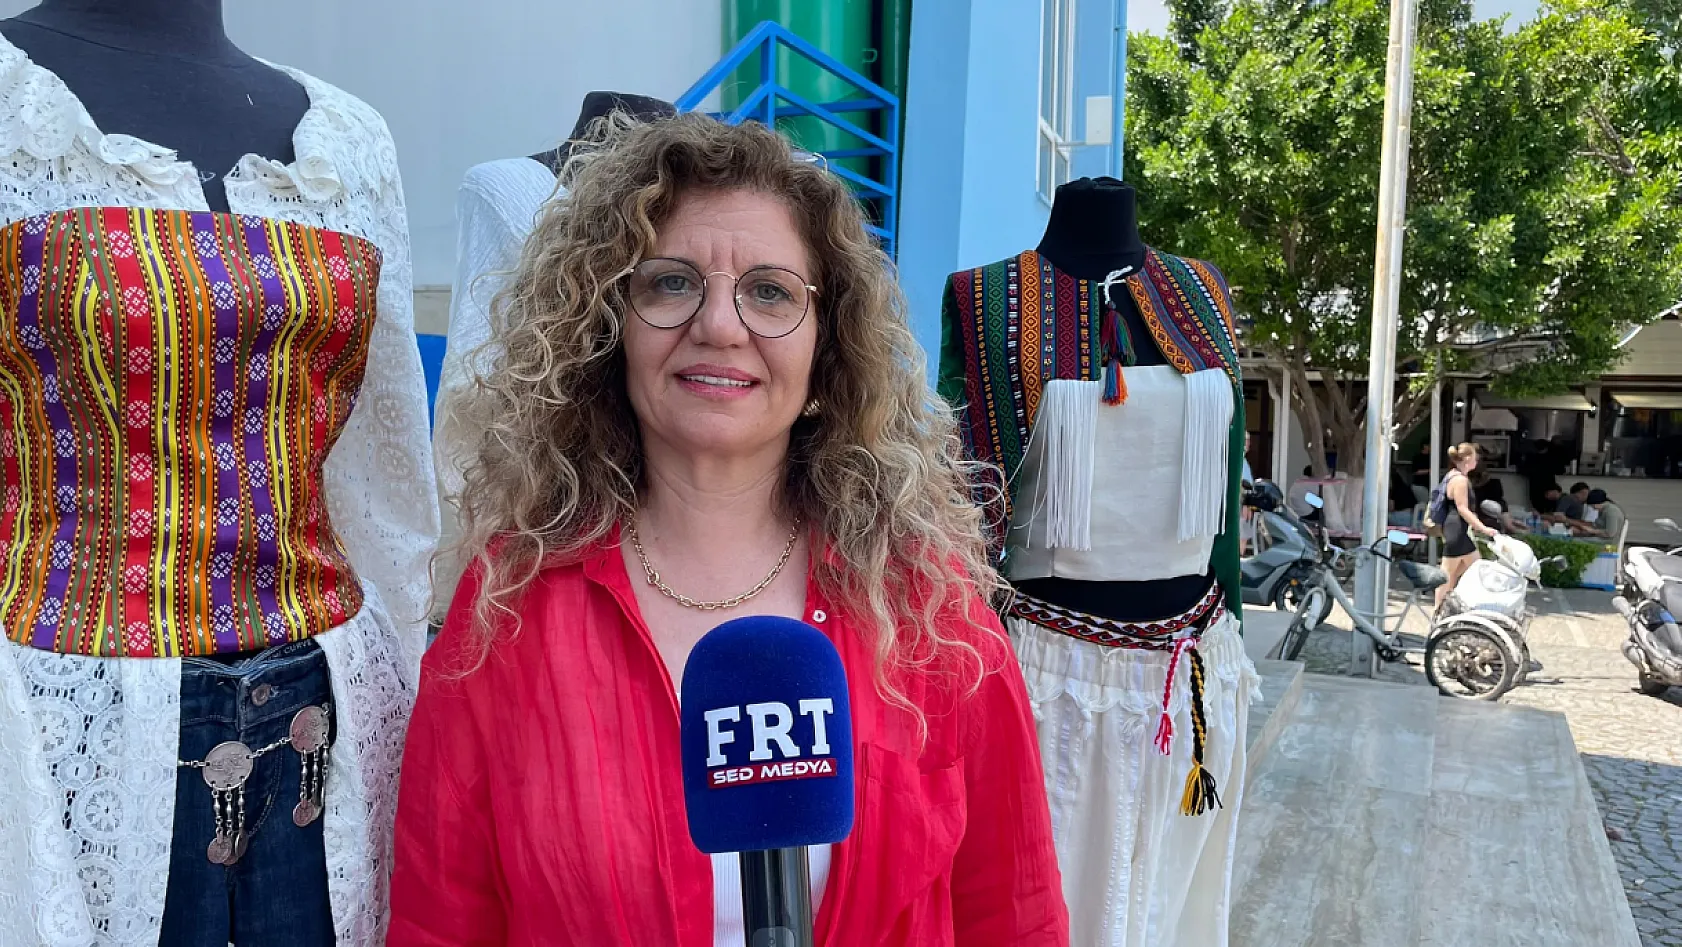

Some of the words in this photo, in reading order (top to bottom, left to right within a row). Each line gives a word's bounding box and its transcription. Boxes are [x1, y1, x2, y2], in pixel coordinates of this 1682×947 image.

[704, 698, 834, 767] FRT
[713, 767, 754, 785] SED
[760, 759, 832, 779] MEDYA
